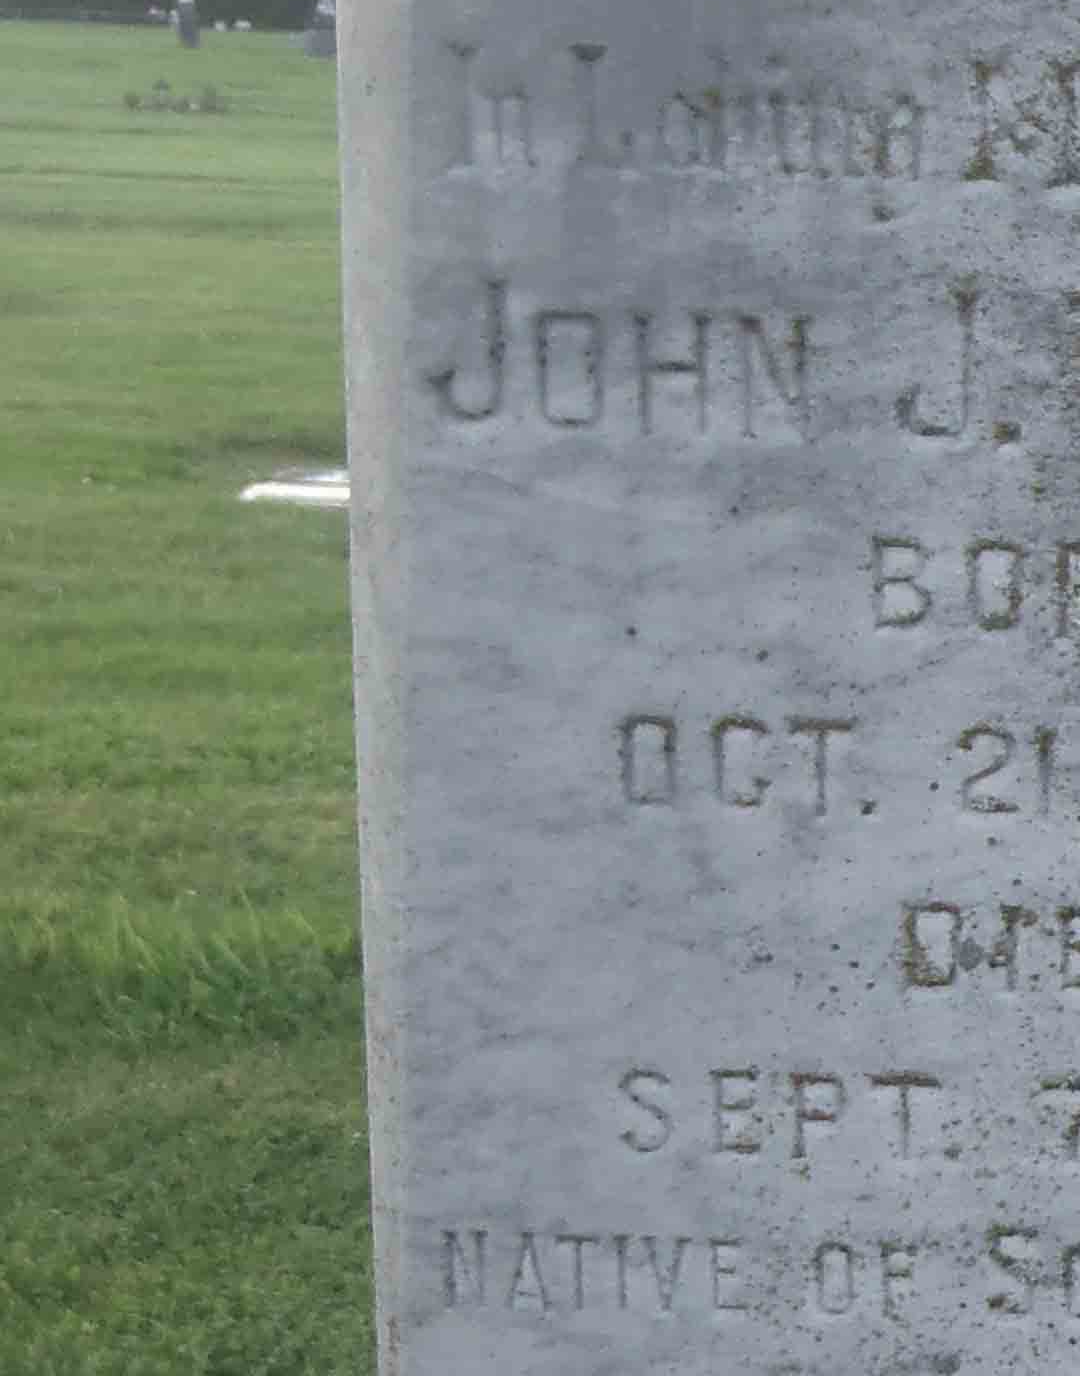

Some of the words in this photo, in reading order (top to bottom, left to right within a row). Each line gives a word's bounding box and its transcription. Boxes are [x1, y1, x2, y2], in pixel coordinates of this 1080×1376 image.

[425, 276, 815, 438] JOHN
[617, 712, 877, 818] OCT.
[440, 1228, 752, 1314] NATIVE
[813, 1238, 918, 1324] OF
